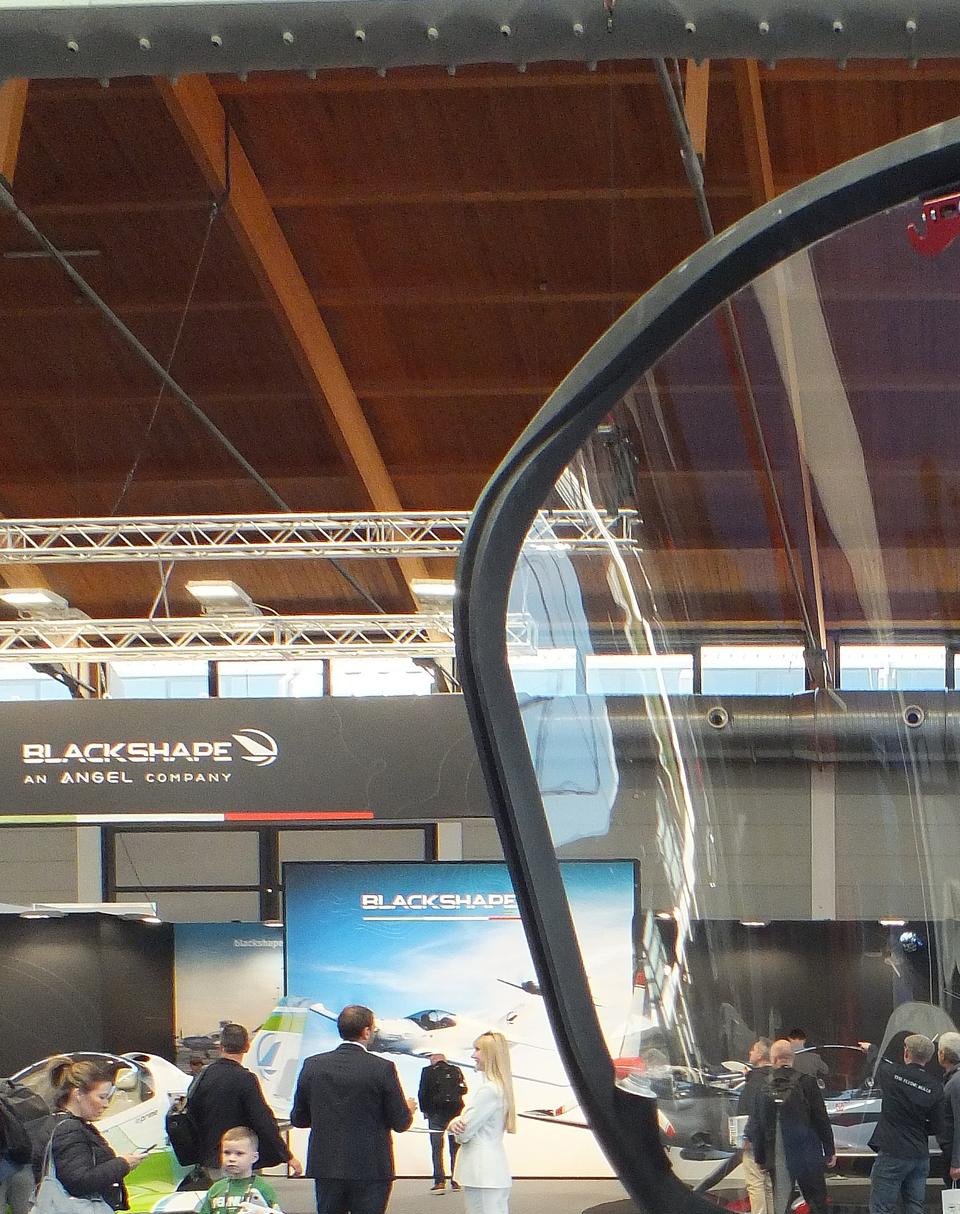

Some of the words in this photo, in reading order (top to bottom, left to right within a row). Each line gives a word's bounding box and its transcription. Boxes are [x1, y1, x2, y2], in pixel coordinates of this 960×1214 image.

[22, 742, 233, 764] BLACKSHAPE
[24, 774, 47, 784] AN
[60, 771, 134, 784] ANGEL
[146, 773, 233, 783] COMPANY
[361, 894, 518, 910] BLACKSHAPE
